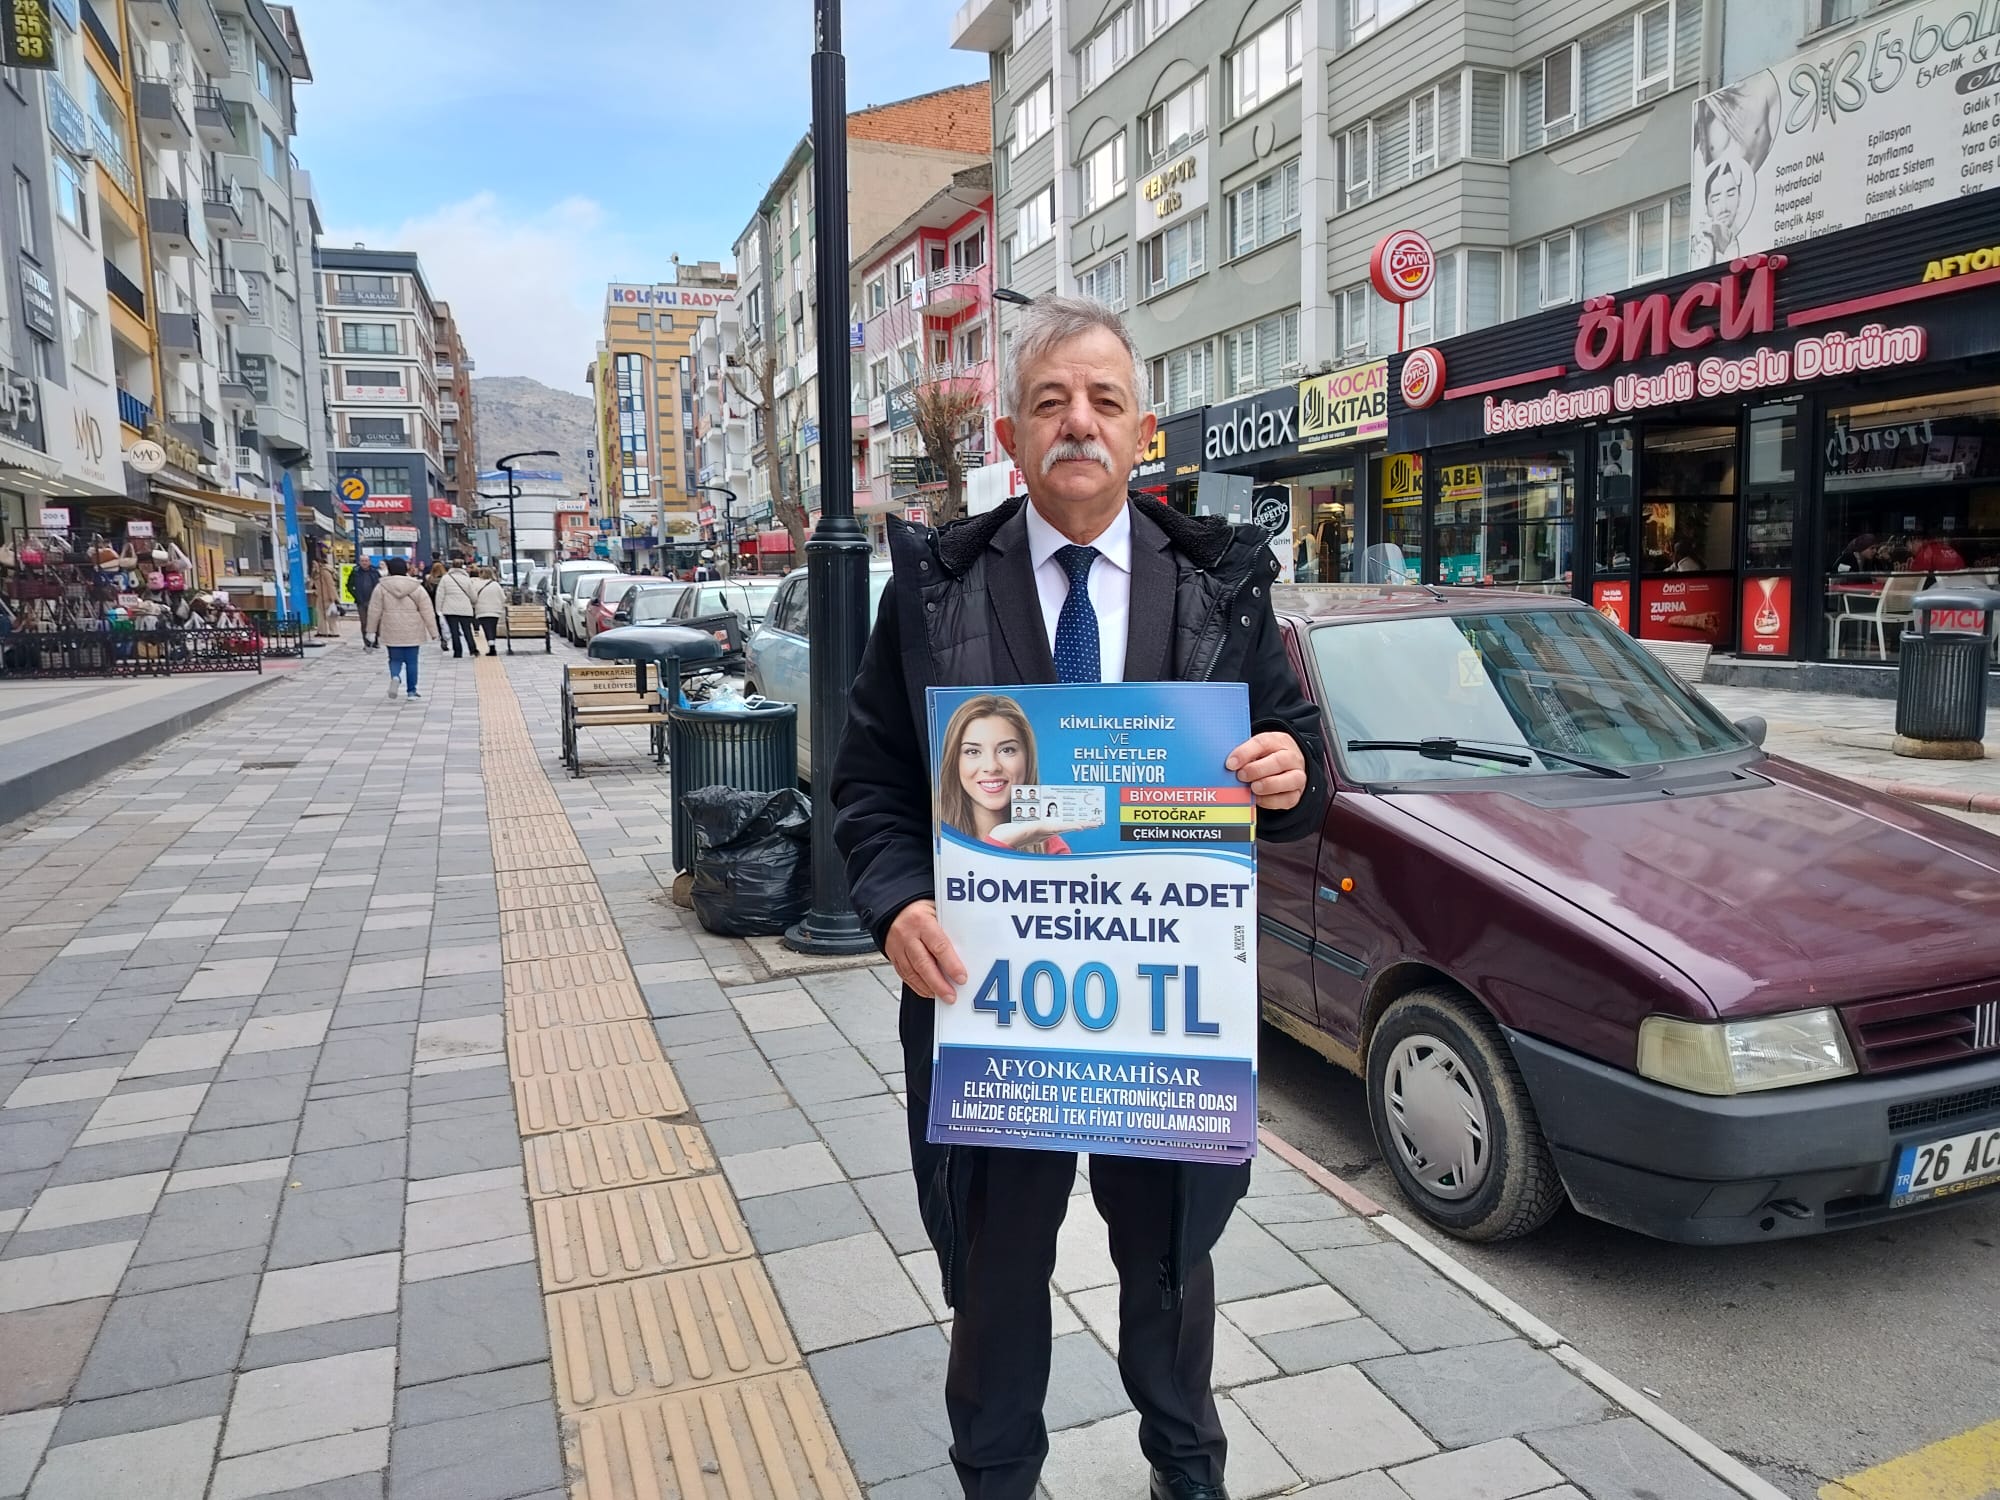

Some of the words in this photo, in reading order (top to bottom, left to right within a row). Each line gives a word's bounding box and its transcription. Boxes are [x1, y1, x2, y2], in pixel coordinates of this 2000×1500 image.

[15, 15, 41, 35] 55
[16, 36, 44, 58] 33
[1867, 124, 1912, 149] Epilasyon
[1961, 120, 1988, 137] Akne
[1961, 142, 1985, 158] Yara
[1775, 160, 1803, 178] Somon
[1805, 151, 1825, 168] DNA
[1902, 157, 1935, 176] Sistem
[1960, 160, 1993, 178] Güneş
[1775, 169, 1822, 198] Hydrafacial
[1774, 191, 1813, 215] Aquapeel
[1865, 185, 1897, 206] Gözenek
[1774, 212, 1804, 232] Gençlik
[1484, 384, 1611, 435] İskenderun
[1614, 361, 1698, 412] Usulü
[1698, 346, 1792, 398] Soslu
[1795, 323, 1927, 380] Dürüm
[1205, 402, 1299, 460] addax
[363, 499, 404, 509] BANK
[1650, 602, 1687, 613] ZURNA
[1060, 714, 1176, 731] KİMLİKLERİNİZ
[1109, 733, 1129, 745] VE
[1074, 745, 1168, 762] EHLİYETLER
[1071, 762, 1165, 784] YENİLENİYOR
[1129, 788, 1217, 803] BİYOMETRİK
[1133, 807, 1207, 822] FOTOĞRAF
[1132, 828, 1171, 842] ÇEKİM
[1171, 828, 1222, 840] NOKTASI
[946, 870, 1122, 906] BİOMETRİK
[1130, 882, 1153, 906] 4
[1160, 882, 1250, 908] ADET
[1011, 908, 1181, 944] VESİKALIK
[972, 958, 1119, 1032] 400
[1136, 962, 1221, 1036] TL
[984, 1057, 1203, 1088] AFYONKARAHİSAR
[963, 1080, 1058, 1103] ELEKTRİKÇİLER
[1061, 1086, 1078, 1103] VE
[1080, 1084, 1196, 1112] ELEKTRONİKÇİLER
[1198, 1092, 1238, 1112] ODASI
[951, 1099, 1006, 1122] İLİMİZDE
[1007, 1103, 1060, 1126] GEÇERLİ
[1062, 1107, 1087, 1126] TEK
[1089, 1106, 1125, 1129] FİYAT
[1126, 1111, 1232, 1135] UYGULAMASIDIR
[1913, 1144, 1953, 1187] 26
[1962, 1132, 2000, 1175] AC
[1897, 1174, 1911, 1187] TR
